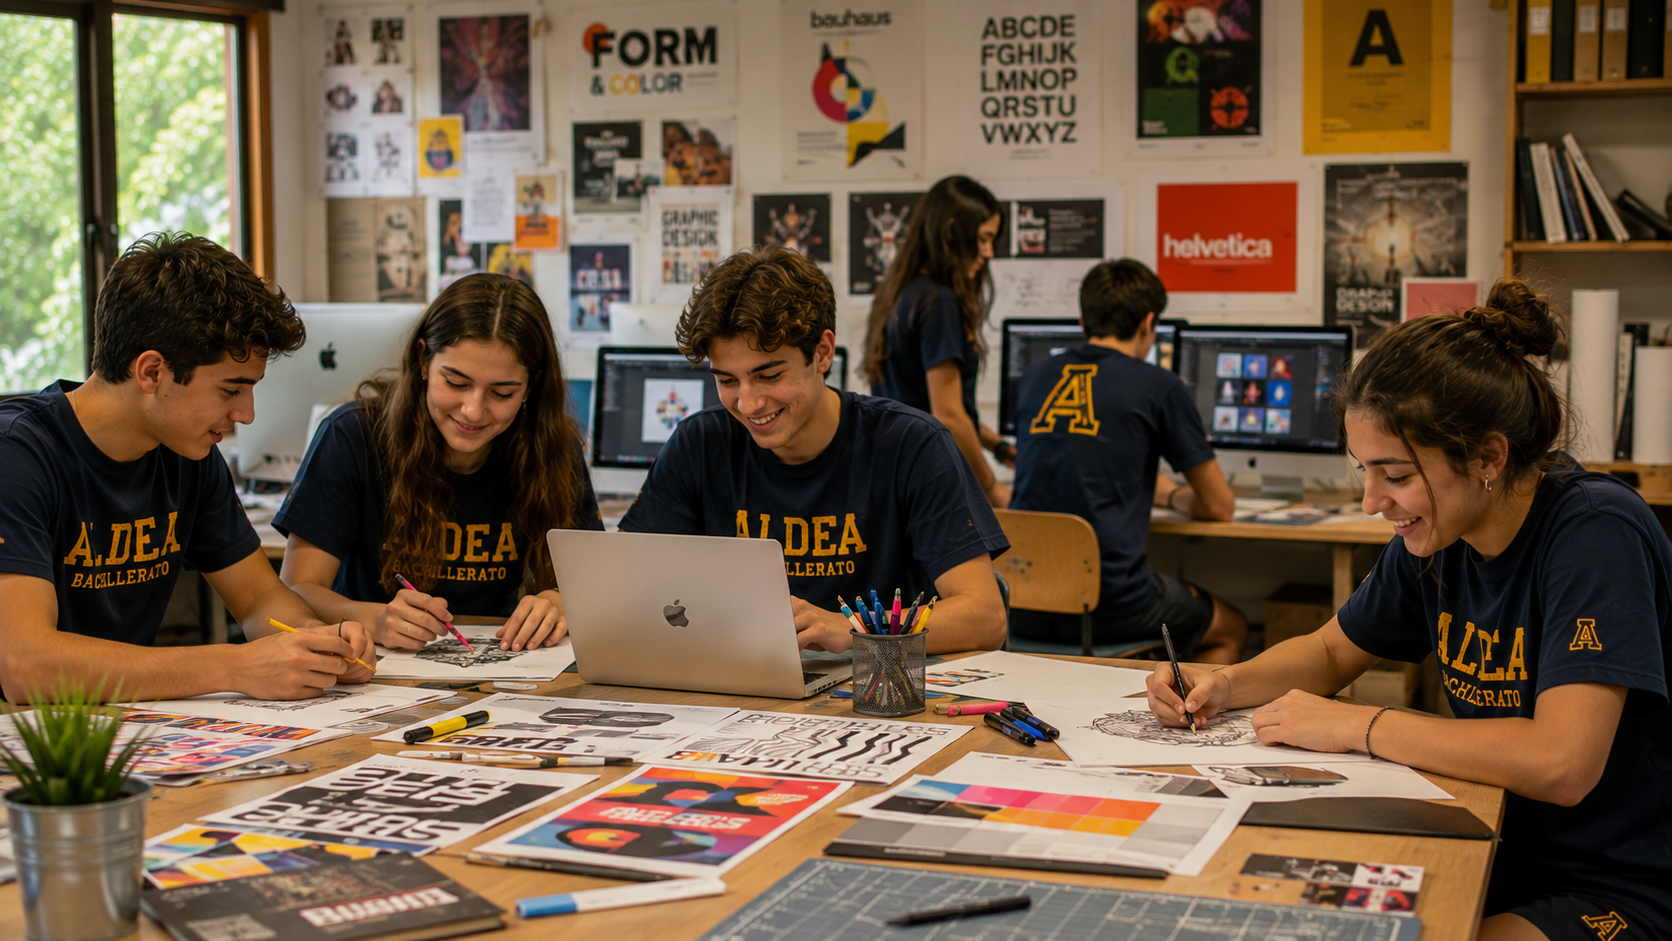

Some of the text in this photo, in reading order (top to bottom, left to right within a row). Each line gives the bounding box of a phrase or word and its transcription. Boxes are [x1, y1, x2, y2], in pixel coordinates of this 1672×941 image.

[810, 9, 892, 29] bauhaus
[981, 14, 1076, 40] ABCDE
[591, 26, 718, 69] FORM
[1349, 9, 1404, 68] A
[981, 41, 1077, 66] FGHIJK
[590, 75, 604, 96] &
[609, 73, 682, 95] COLOR
[981, 68, 1078, 92] LMNOP
[981, 95, 1076, 118] QRSTU
[981, 121, 1077, 144] VWXYZ
[1163, 232, 1273, 259] helvetica
[1029, 364, 1100, 436] A
[1569, 618, 1602, 651] A
